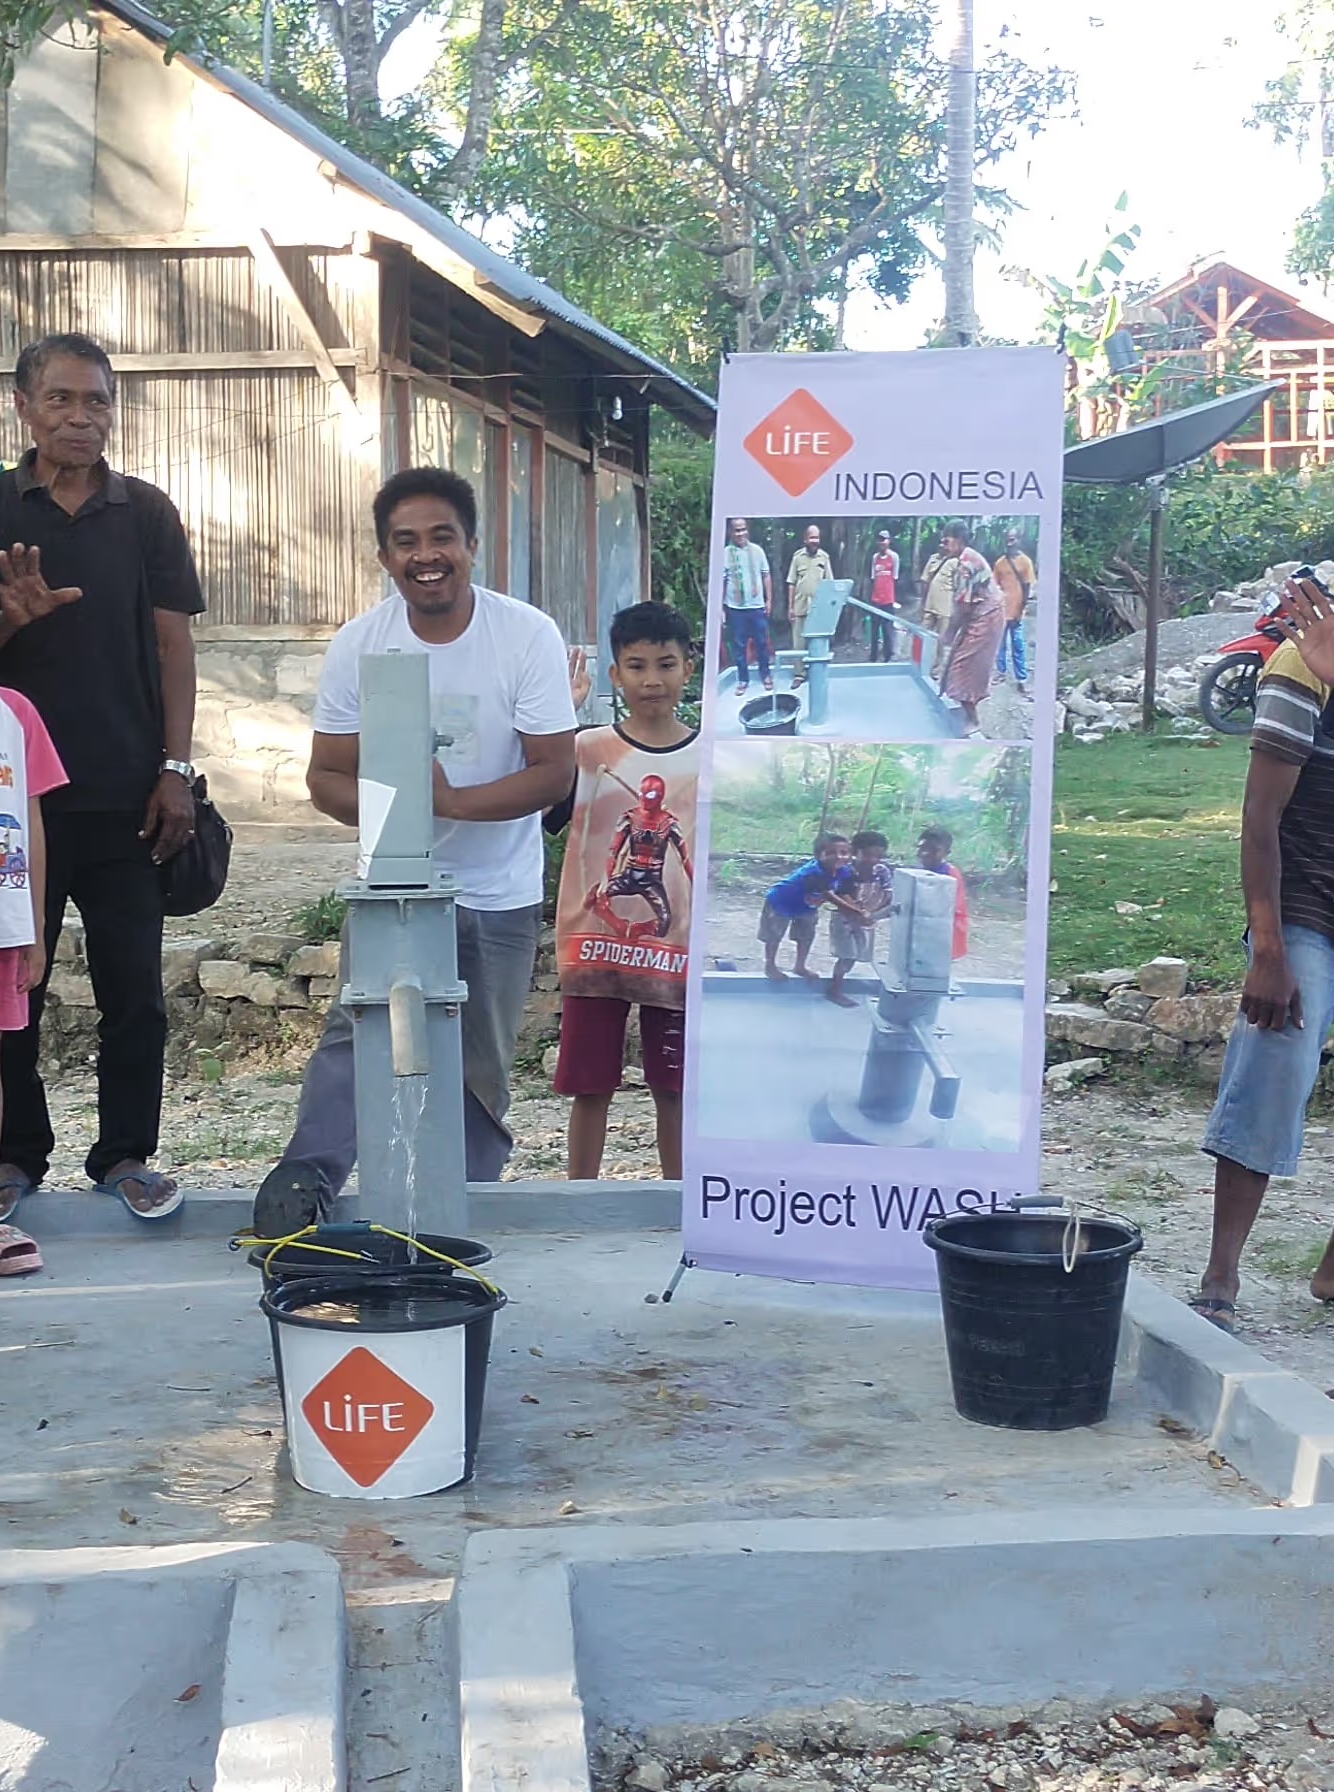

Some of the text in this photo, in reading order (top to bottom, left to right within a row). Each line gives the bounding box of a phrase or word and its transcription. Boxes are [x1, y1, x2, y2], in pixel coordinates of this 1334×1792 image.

[834, 471, 1045, 501] INDONESIA
[579, 940, 688, 973] SPIDERMAN
[702, 1175, 857, 1236] Project
